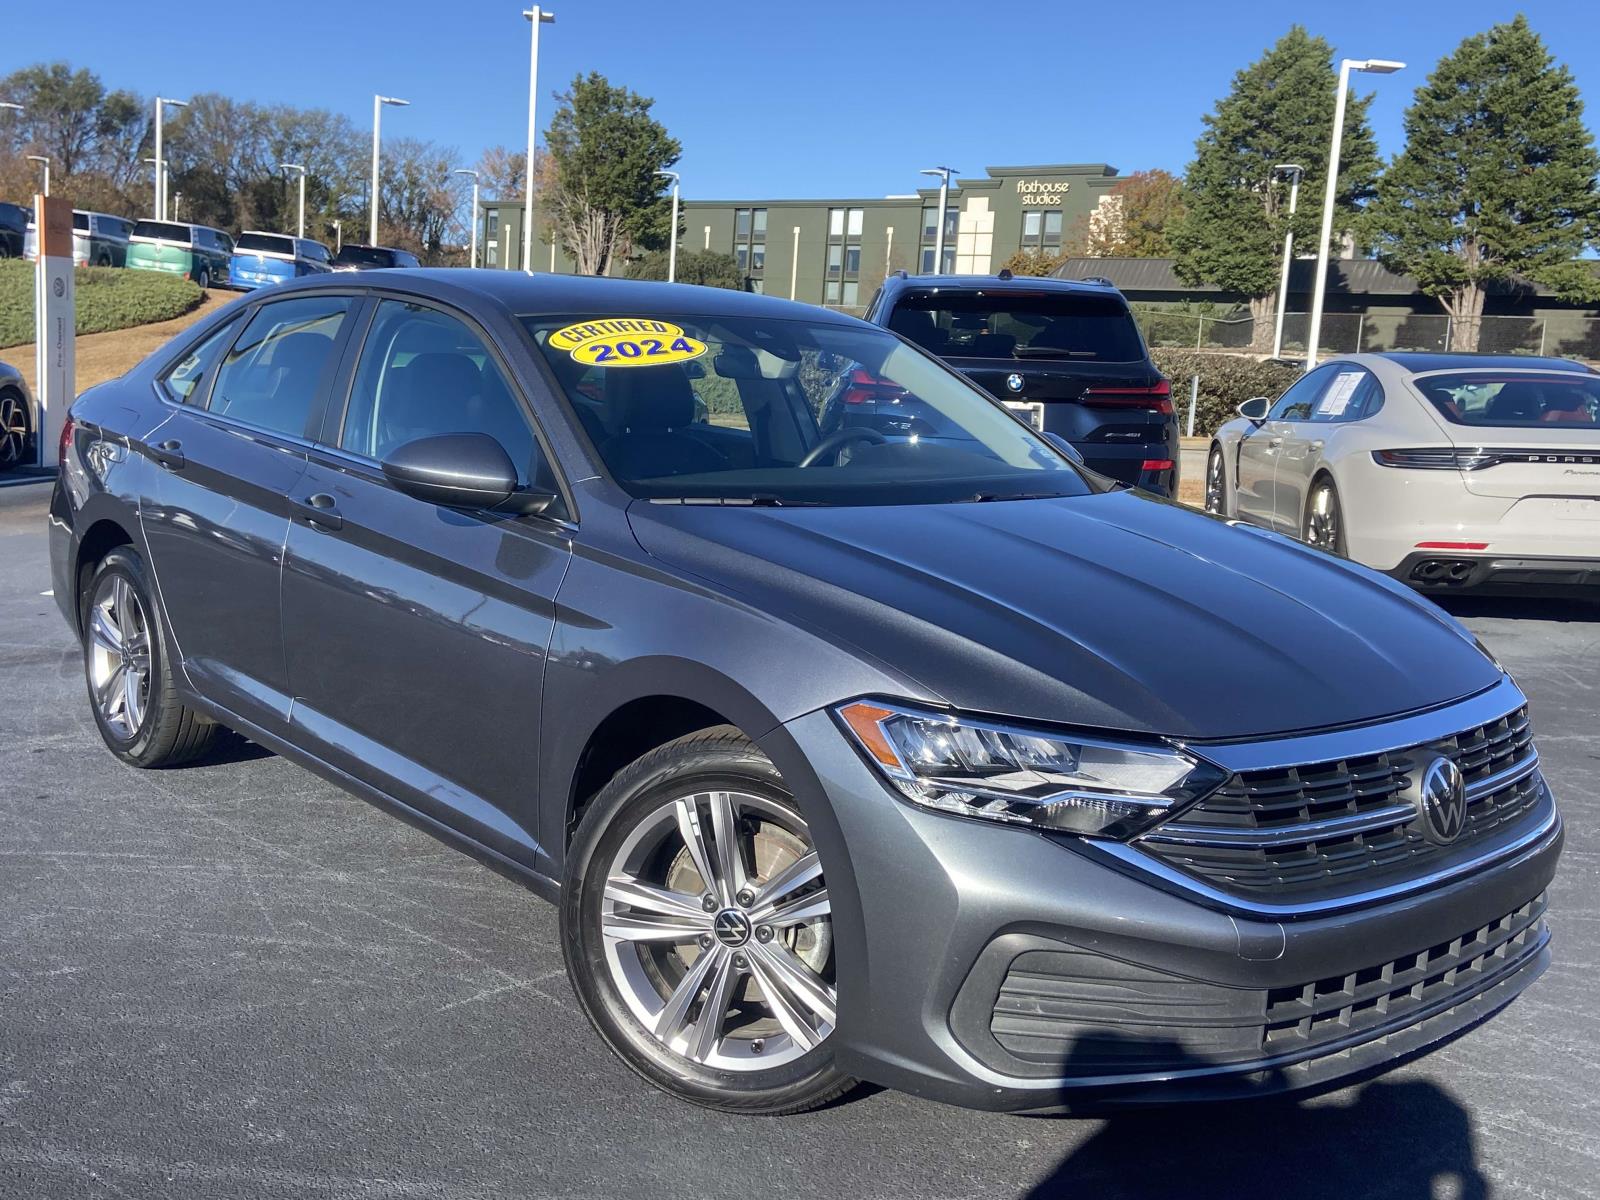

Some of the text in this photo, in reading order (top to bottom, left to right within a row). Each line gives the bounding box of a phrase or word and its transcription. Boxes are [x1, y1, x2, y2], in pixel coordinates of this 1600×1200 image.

[1017, 180, 1069, 193] flathouse
[1022, 193, 1061, 205] studios
[560, 320, 667, 343] CERTIFIED
[589, 338, 694, 363] 2024
